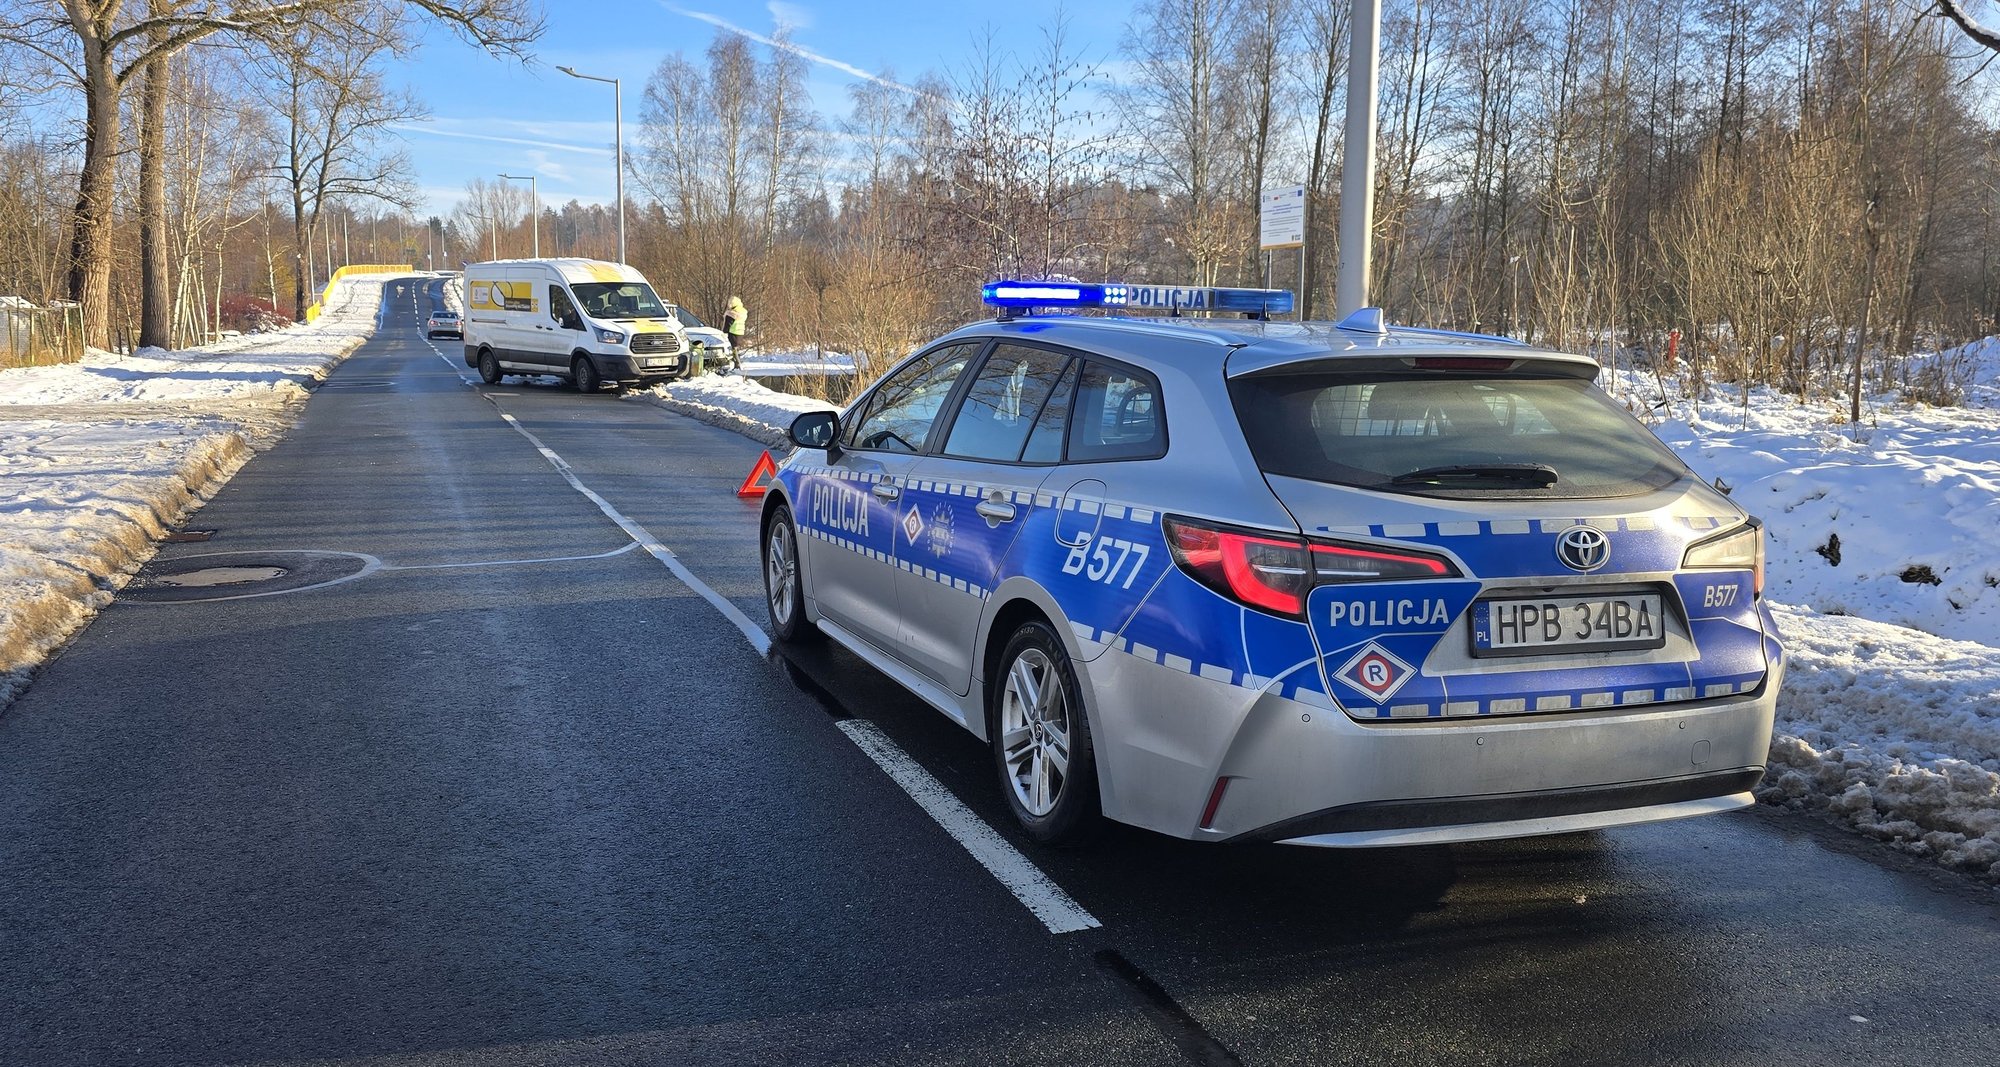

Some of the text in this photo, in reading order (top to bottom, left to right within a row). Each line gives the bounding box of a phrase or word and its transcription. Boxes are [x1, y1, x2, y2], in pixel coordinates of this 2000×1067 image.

[1131, 287, 1205, 308] POLICJA
[813, 483, 869, 537] POLICJA
[1062, 531, 1151, 590] B577
[1703, 584, 1739, 608] B577
[1330, 598, 1449, 627] POLICJA
[1498, 600, 1653, 643] HPB 34BA
[1476, 631, 1489, 642] PL
[1369, 664, 1384, 682] R
